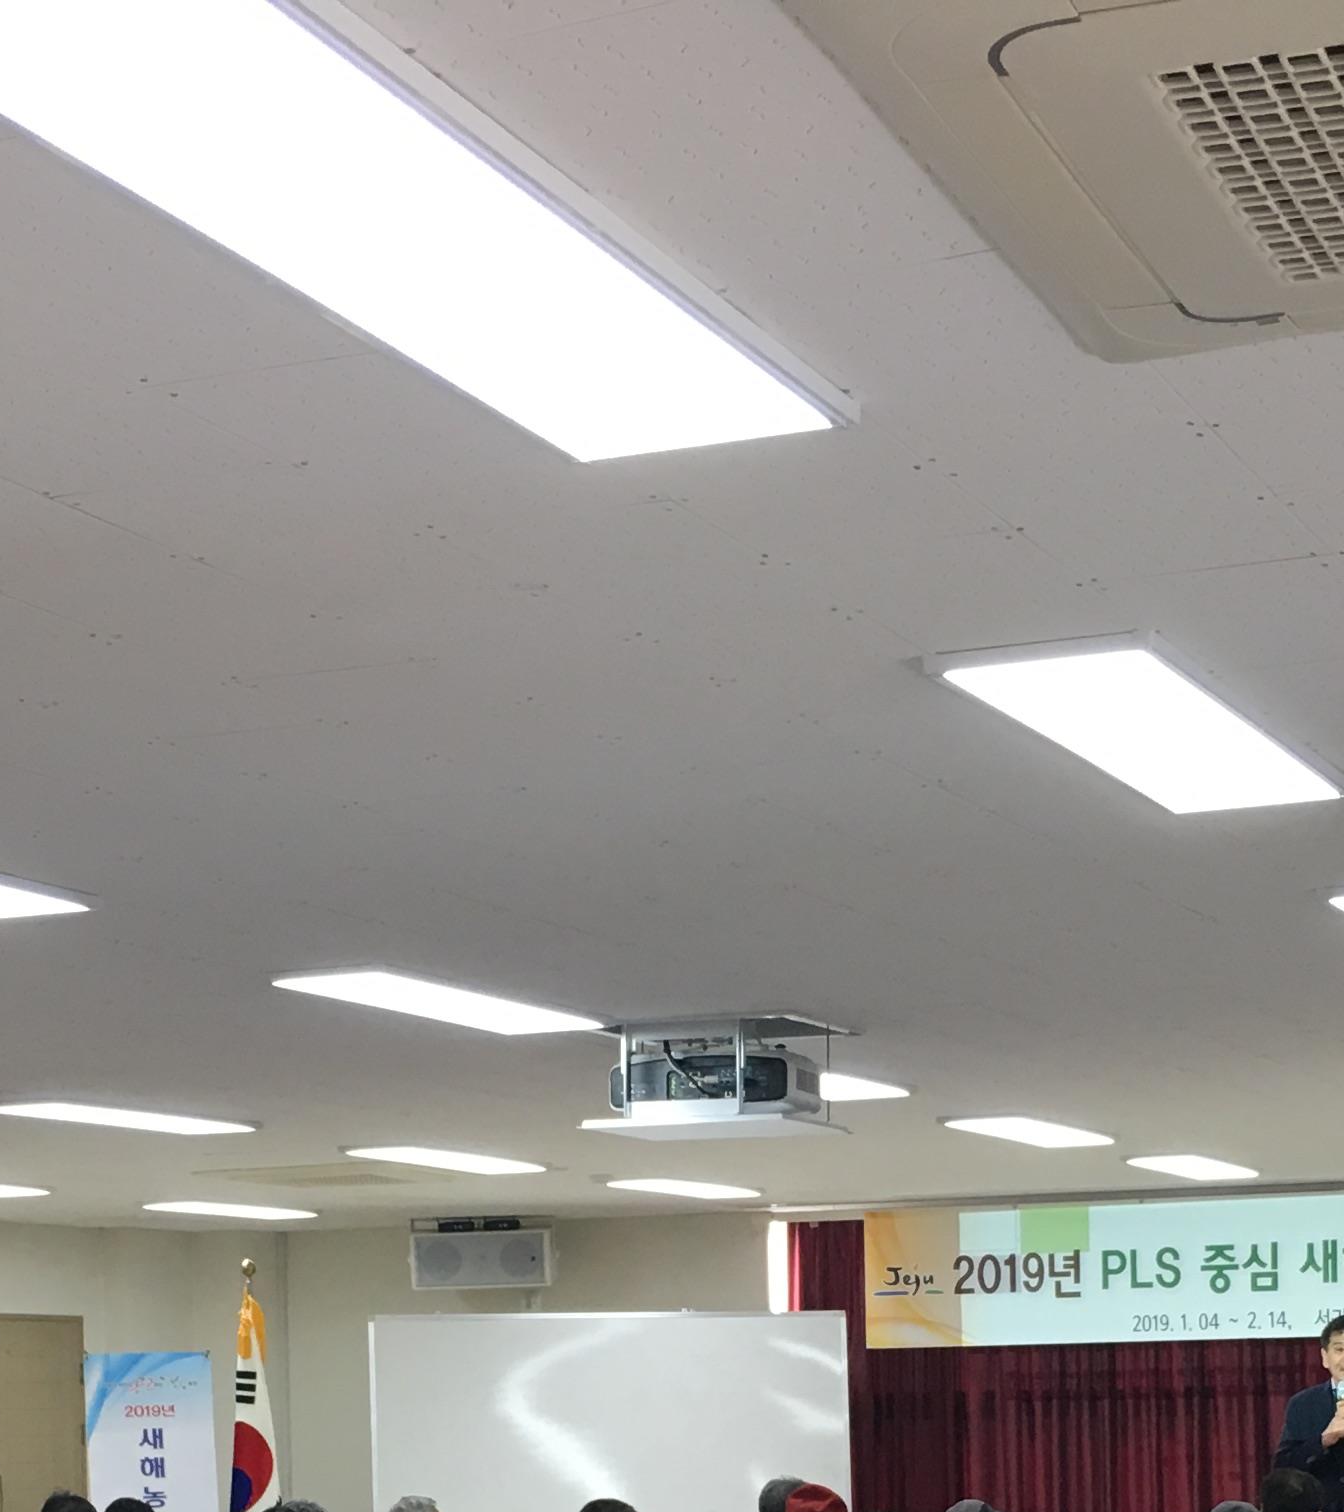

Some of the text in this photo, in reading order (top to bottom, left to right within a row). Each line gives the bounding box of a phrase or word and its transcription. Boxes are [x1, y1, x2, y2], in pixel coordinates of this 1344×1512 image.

[883, 1265, 934, 1296] Jeju
[953, 1249, 1081, 1298] 2019년
[1102, 1247, 1181, 1289] PLS
[1201, 1242, 1278, 1293] 중심
[1132, 1313, 1174, 1332] 2019.
[1181, 1313, 1193, 1331] 1.
[1198, 1312, 1220, 1330] 04
[1248, 1311, 1262, 1329] 2.
[124, 1404, 176, 1418] 2019년
